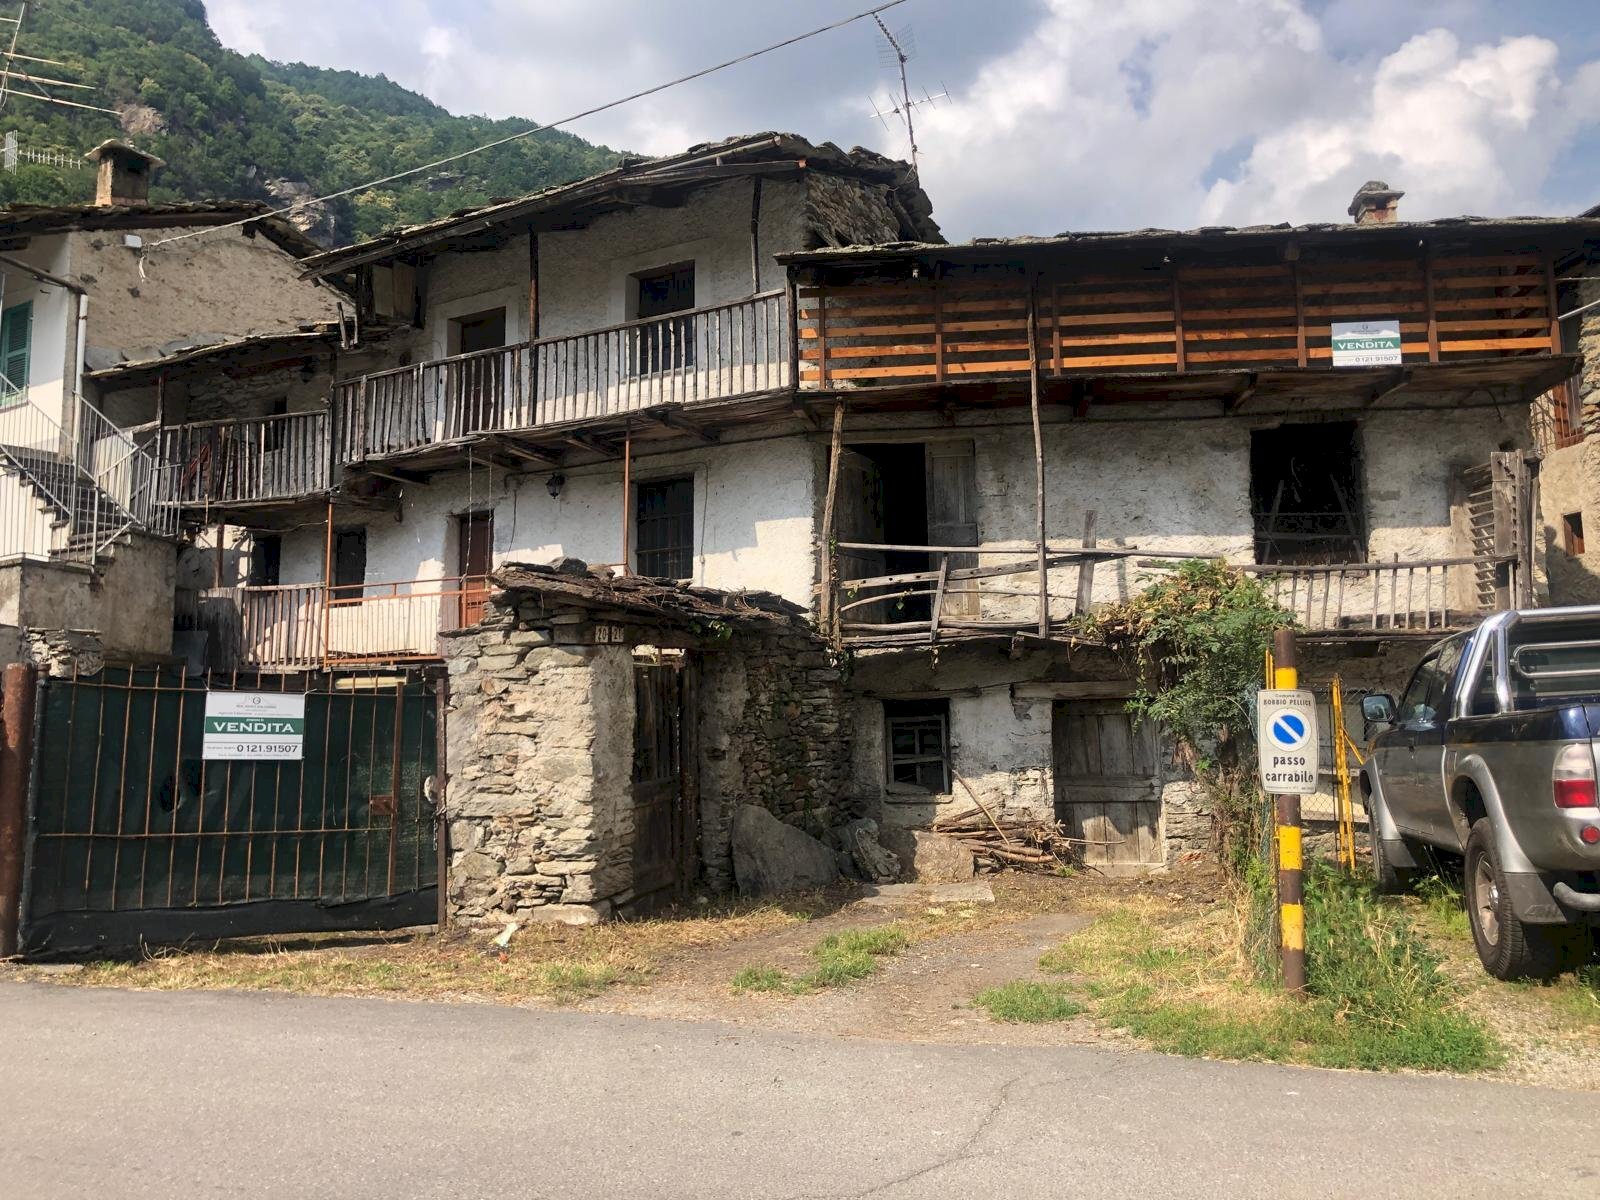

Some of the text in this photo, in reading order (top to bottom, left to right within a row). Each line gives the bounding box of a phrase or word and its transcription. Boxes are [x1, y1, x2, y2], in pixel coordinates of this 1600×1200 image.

[1337, 340, 1394, 350] VENDITA
[1289, 699, 1312, 707] PELLICE
[213, 721, 295, 733] VENDITA
[1273, 756, 1306, 768] passo
[1265, 771, 1314, 783] carrabile
